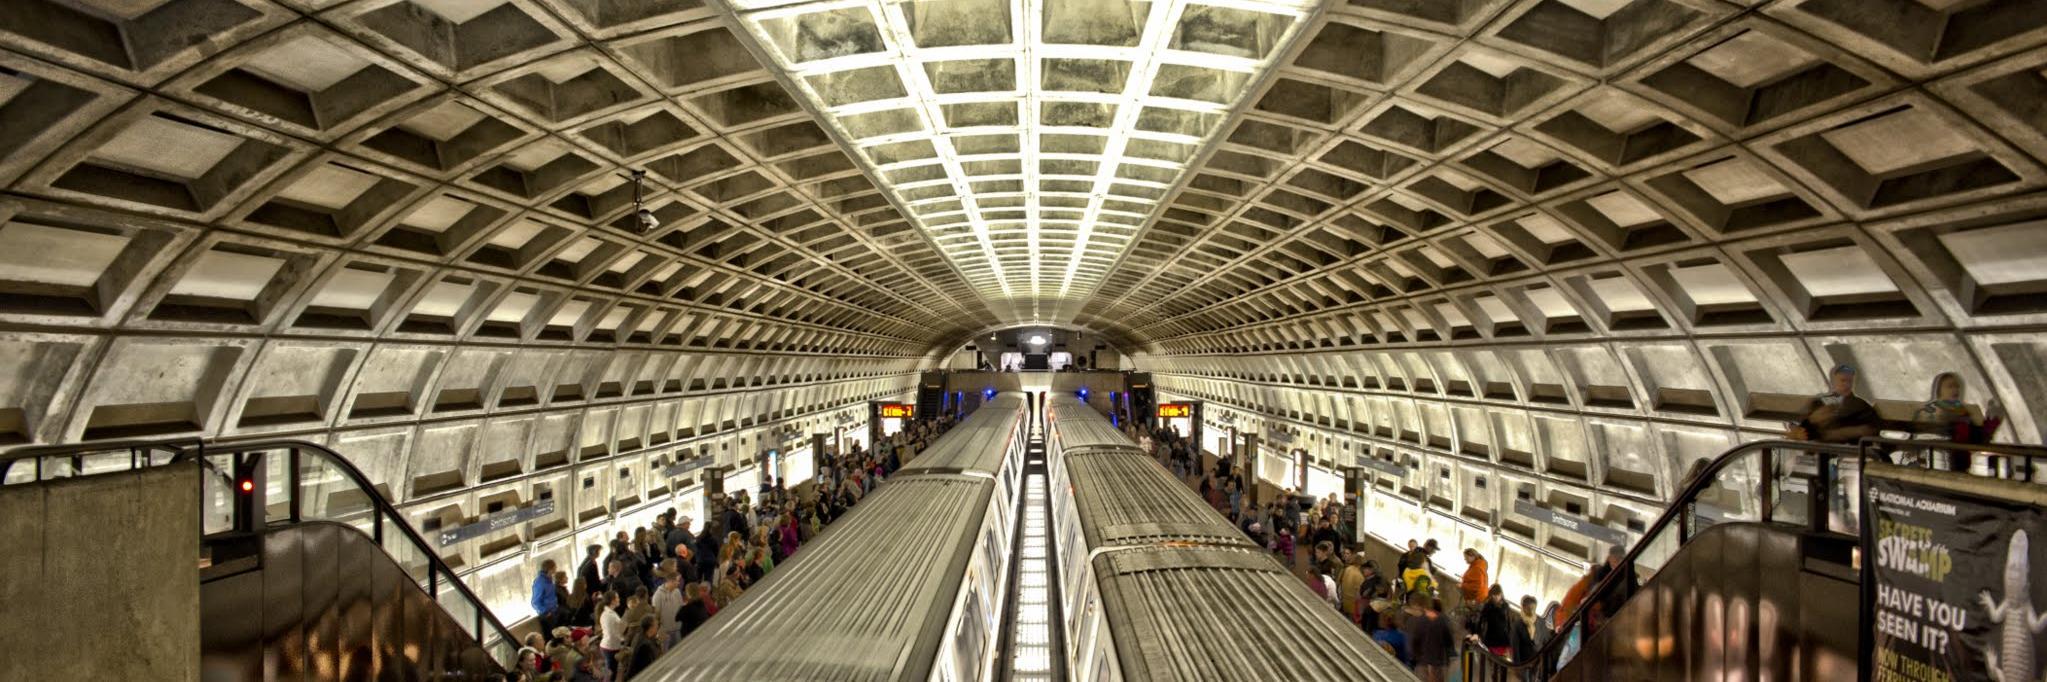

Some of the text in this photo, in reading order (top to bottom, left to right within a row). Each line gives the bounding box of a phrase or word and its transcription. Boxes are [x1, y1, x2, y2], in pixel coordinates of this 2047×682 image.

[1879, 492, 1914, 508] NATIONAL
[1915, 499, 1957, 516] AQUARIUM
[1878, 535, 1952, 583] SWAMP
[1877, 583, 1966, 631] HAVE YOU
[1877, 610, 1949, 654] SEEN IT?
[1878, 646, 1898, 670] NOW
